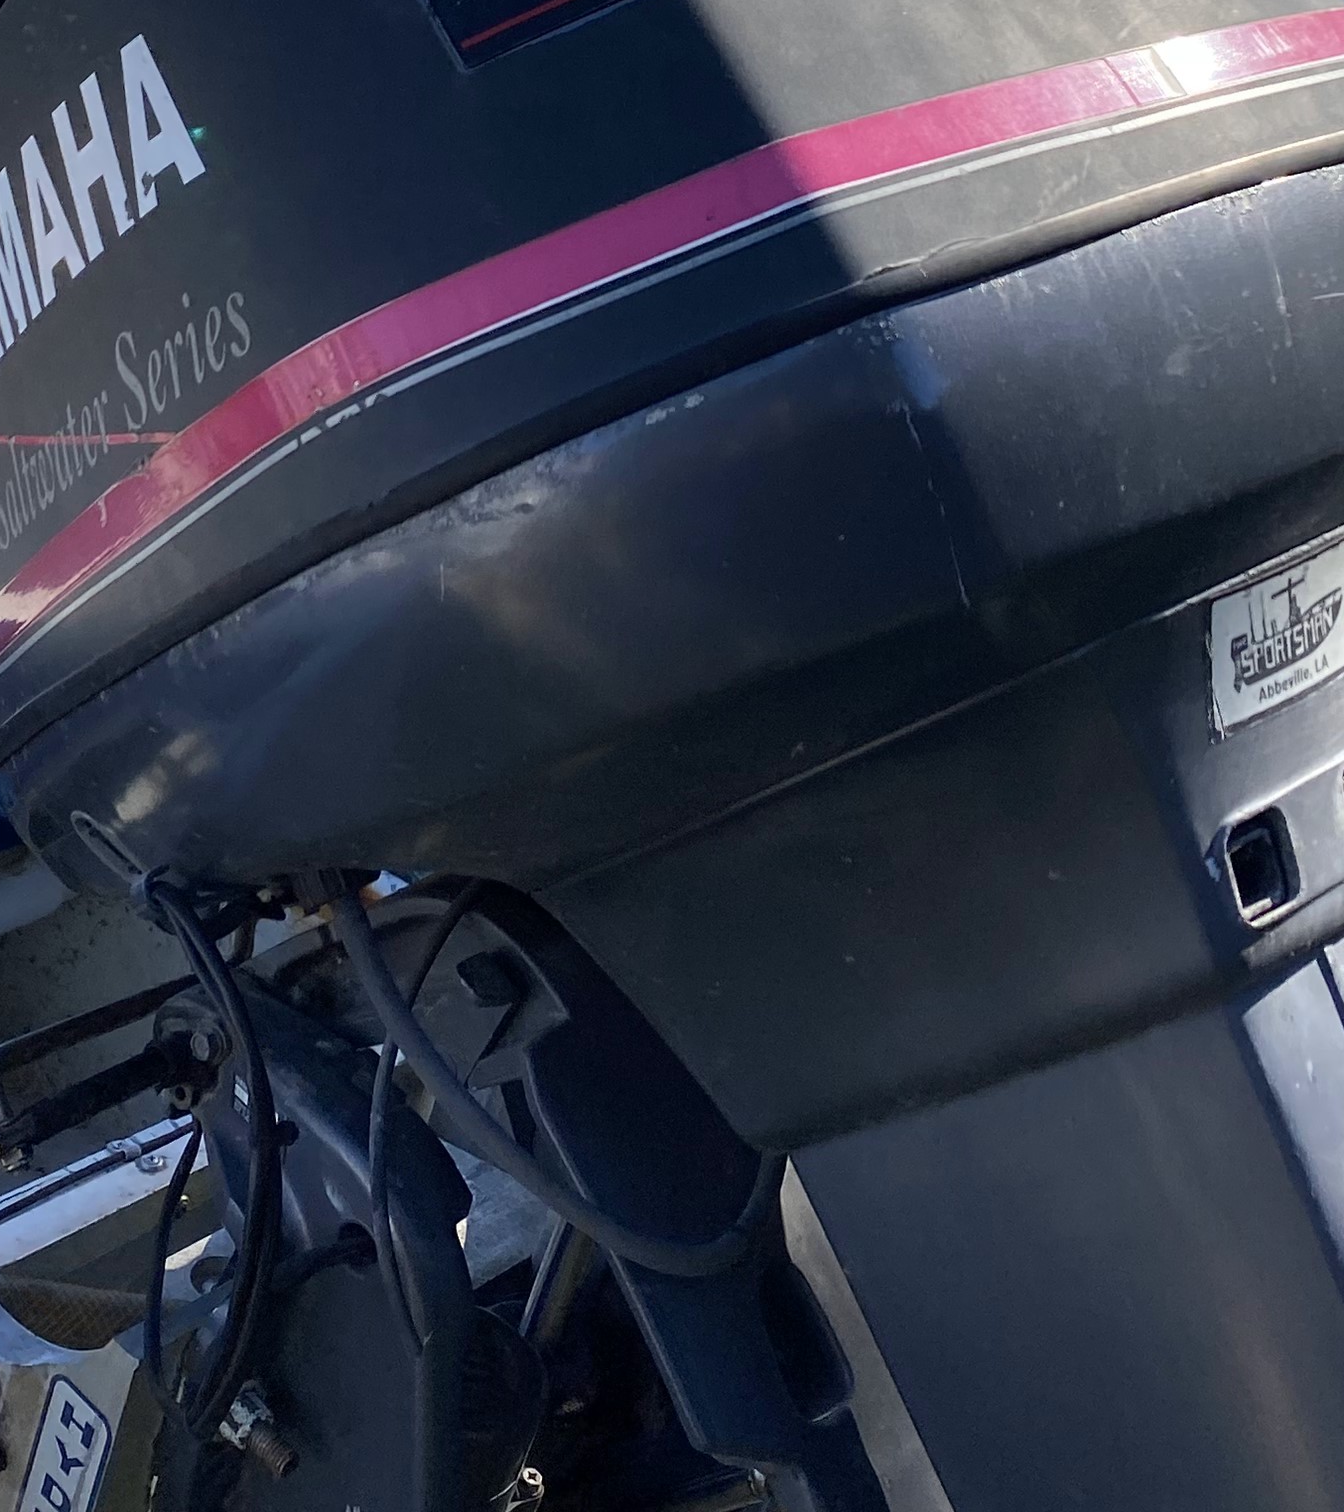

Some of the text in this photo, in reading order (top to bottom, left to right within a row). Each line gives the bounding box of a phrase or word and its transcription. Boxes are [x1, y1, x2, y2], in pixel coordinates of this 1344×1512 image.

[114, 291, 252, 432] Series
[1240, 606, 1334, 678] SPORTSMAN
[1258, 653, 1329, 703] Abbeville, LA
[34, 1399, 95, 1512] HYD
